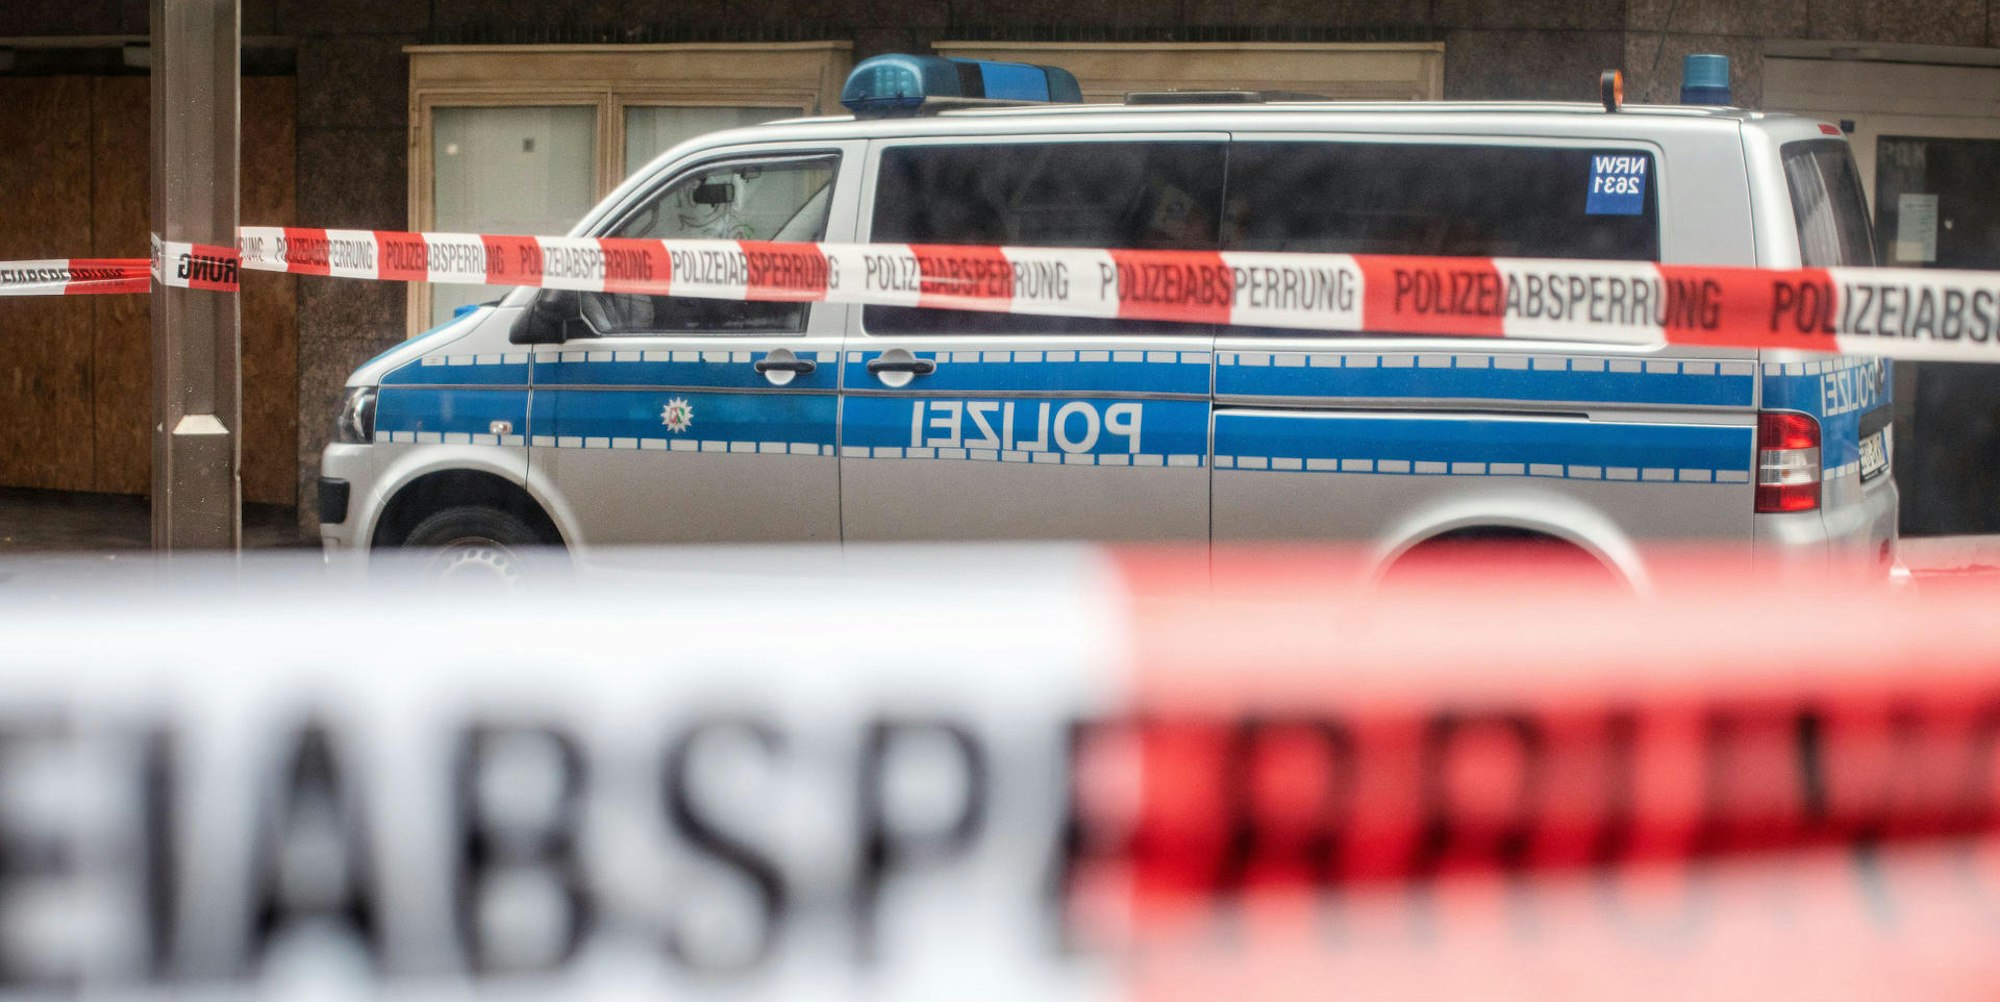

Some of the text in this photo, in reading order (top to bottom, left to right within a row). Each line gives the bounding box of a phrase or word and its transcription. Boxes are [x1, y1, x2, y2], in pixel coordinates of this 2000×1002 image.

[275, 236, 373, 270] POLIZEIABSPERRUNG
[385, 241, 505, 275] POLIZEIABSPERRUNG
[519, 244, 653, 283] POLIZEIABSPERRUNG
[671, 250, 841, 288] POLIZEIABSPERRUNG
[863, 254, 1069, 302] POLIZEIABSPERRUNG
[1098, 260, 1356, 313] POLIZEIABSPERRUNG
[1394, 269, 1721, 330] POLIZEIABSPERRUNG
[1770, 280, 2000, 343] POLIZEIABS
